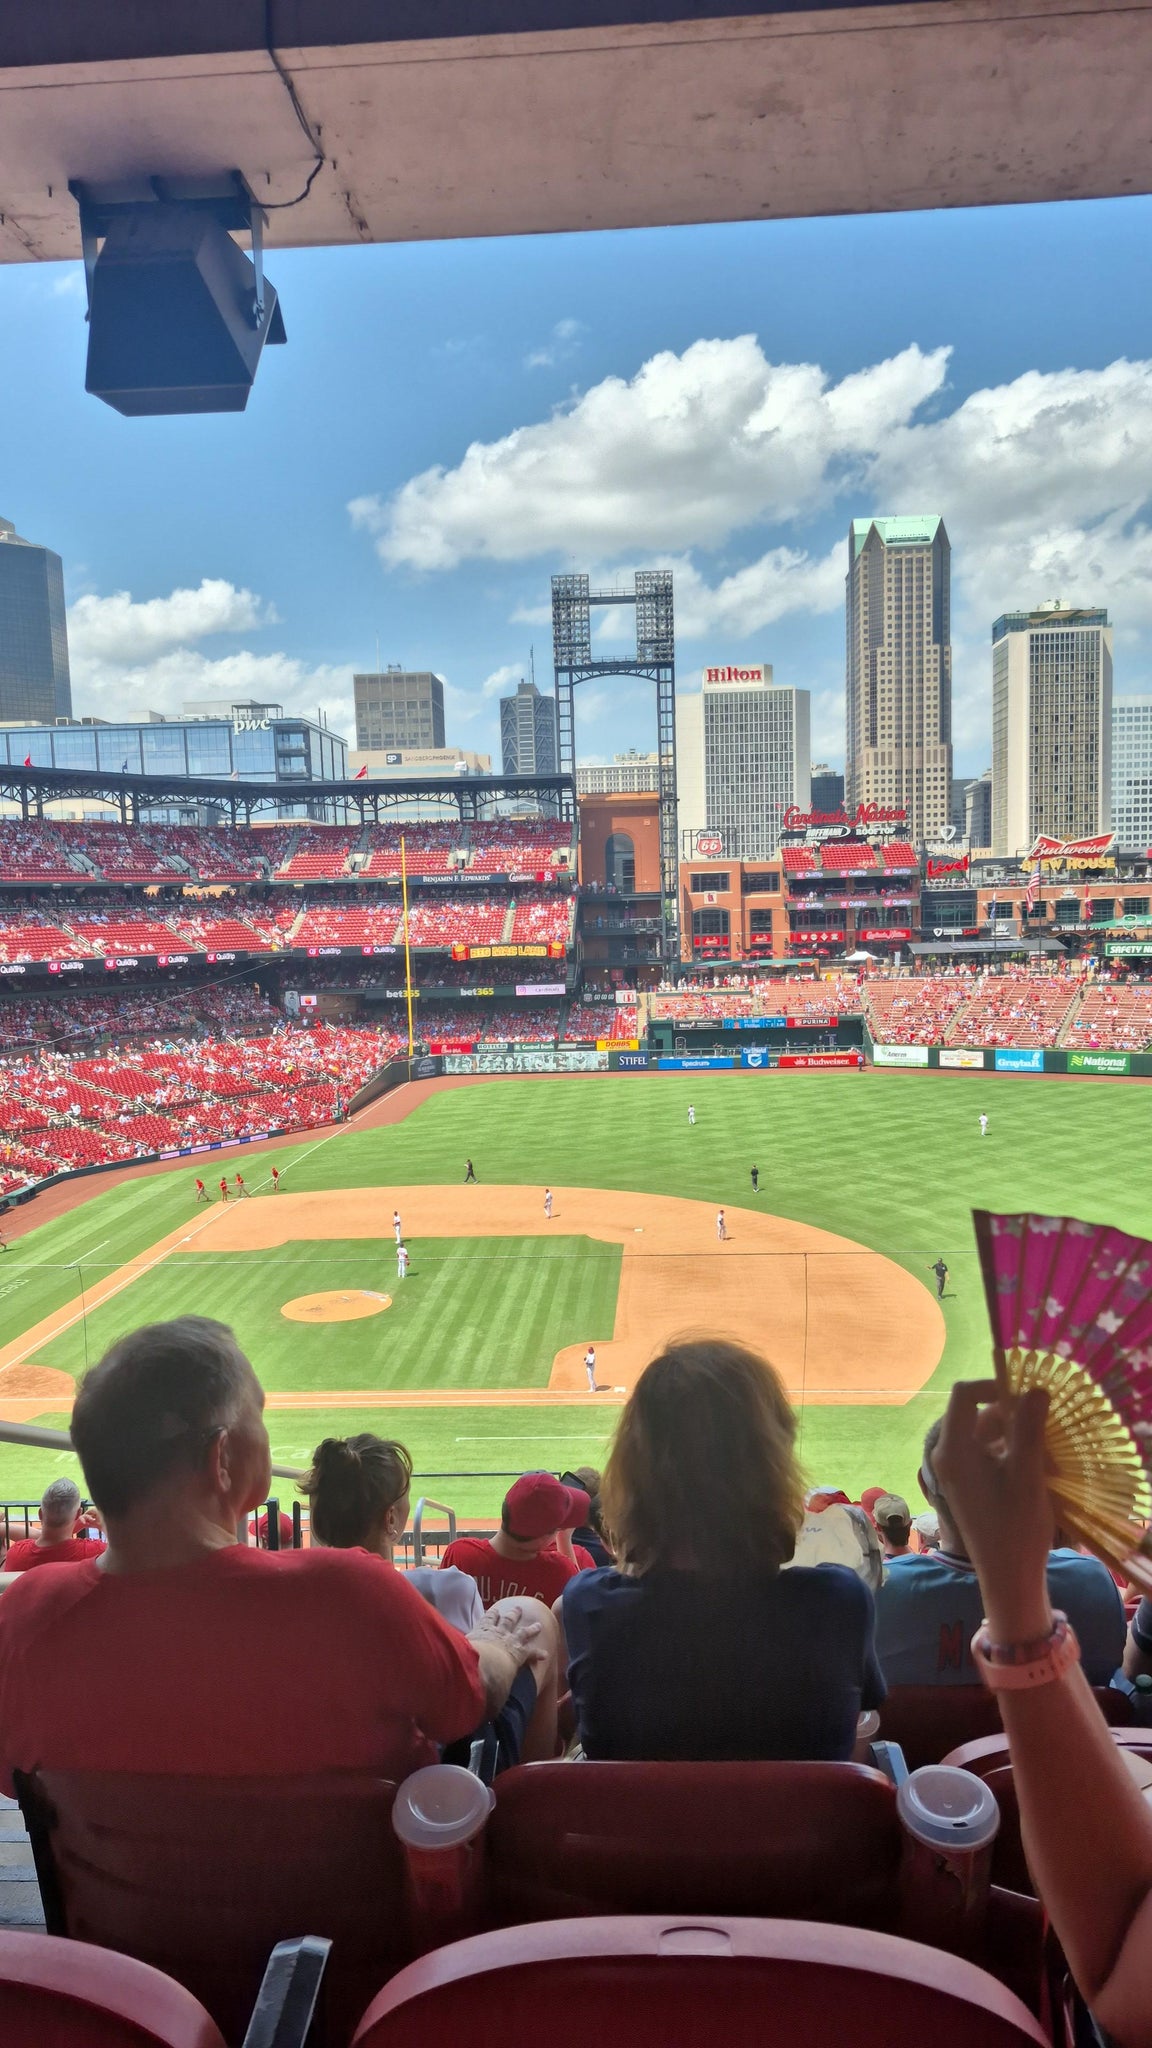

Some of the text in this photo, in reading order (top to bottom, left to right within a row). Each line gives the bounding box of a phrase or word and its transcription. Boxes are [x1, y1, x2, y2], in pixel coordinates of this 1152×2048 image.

[706, 666, 762, 681] Hilton
[233, 719, 272, 735] pwc
[783, 802, 907, 829] Cardinals Nation
[701, 841, 720, 851] 66
[1031, 841, 1108, 857] Budweiser
[927, 855, 969, 877] Live!
[1066, 858, 1116, 870] HOUSE
[509, 872, 535, 882] Cardinals
[1109, 945, 1142, 954] SAFETY
[460, 988, 494, 996] bet365
[619, 1056, 648, 1065] STIFEL
[1083, 1056, 1126, 1067] National
